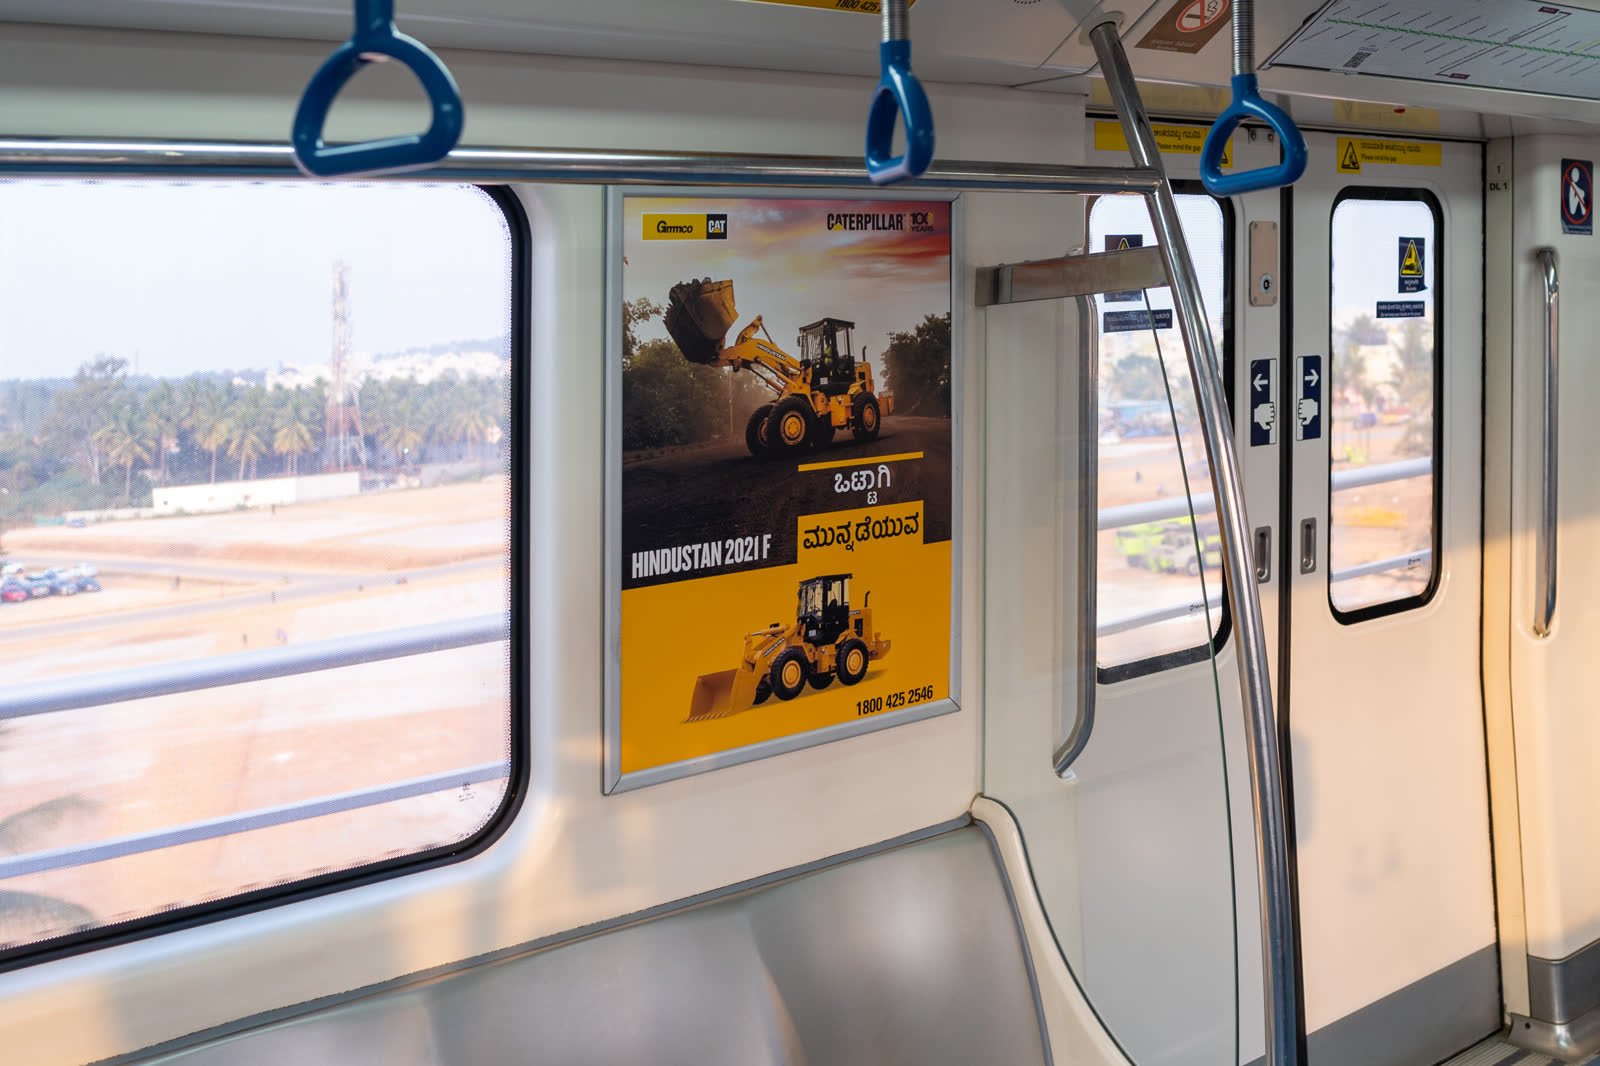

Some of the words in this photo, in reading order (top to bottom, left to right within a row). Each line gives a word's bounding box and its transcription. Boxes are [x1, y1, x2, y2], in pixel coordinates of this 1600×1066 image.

[1489, 182, 1501, 191] DL
[1503, 181, 1508, 190] 1
[708, 220, 725, 233] CAT
[826, 213, 904, 231] CATERPILLAR
[834, 464, 891, 505] ಒಟ್ಟಾಗಿ
[803, 512, 919, 552] ಮುನ್ನಡೆಯುವ
[632, 541, 722, 579] HINDUSTAN
[725, 536, 759, 565] 2021
[762, 533, 772, 559] F
[856, 697, 883, 716] 1800
[885, 692, 905, 709] 425
[908, 685, 934, 704] 2546
